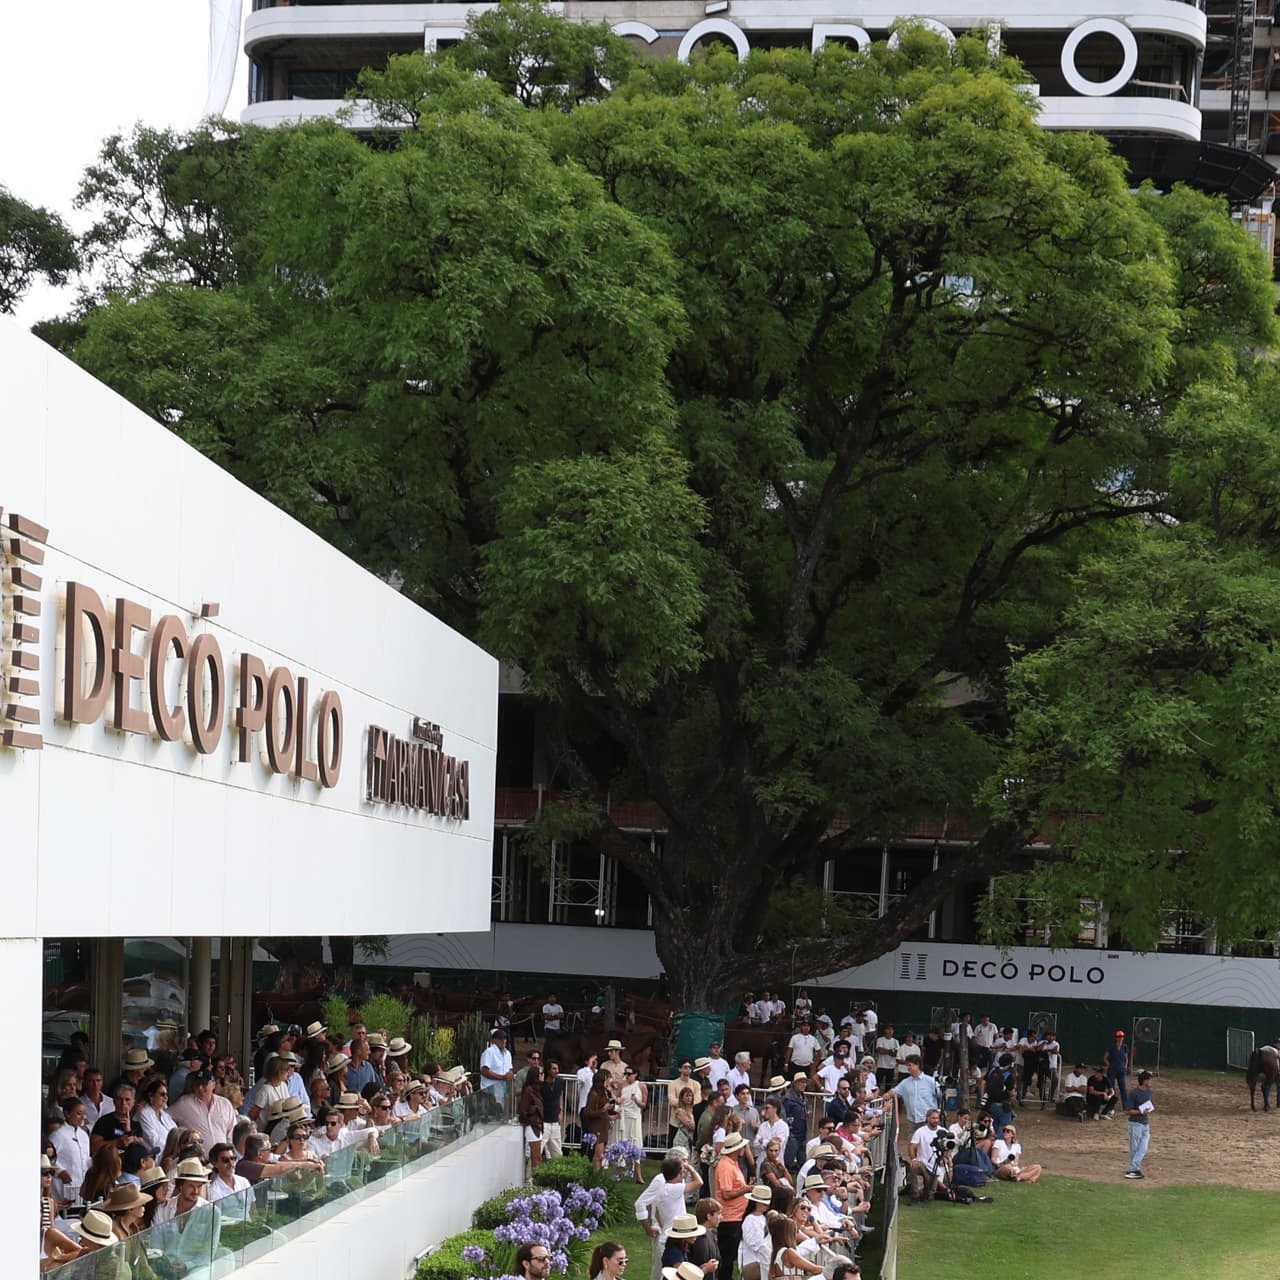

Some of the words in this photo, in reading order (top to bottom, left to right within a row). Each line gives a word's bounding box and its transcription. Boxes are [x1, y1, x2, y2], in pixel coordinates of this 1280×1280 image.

[63, 580, 225, 755] DECÓ
[235, 652, 343, 788] POLO
[942, 958, 1019, 980] DECÓ
[1029, 963, 1105, 985] POLO
